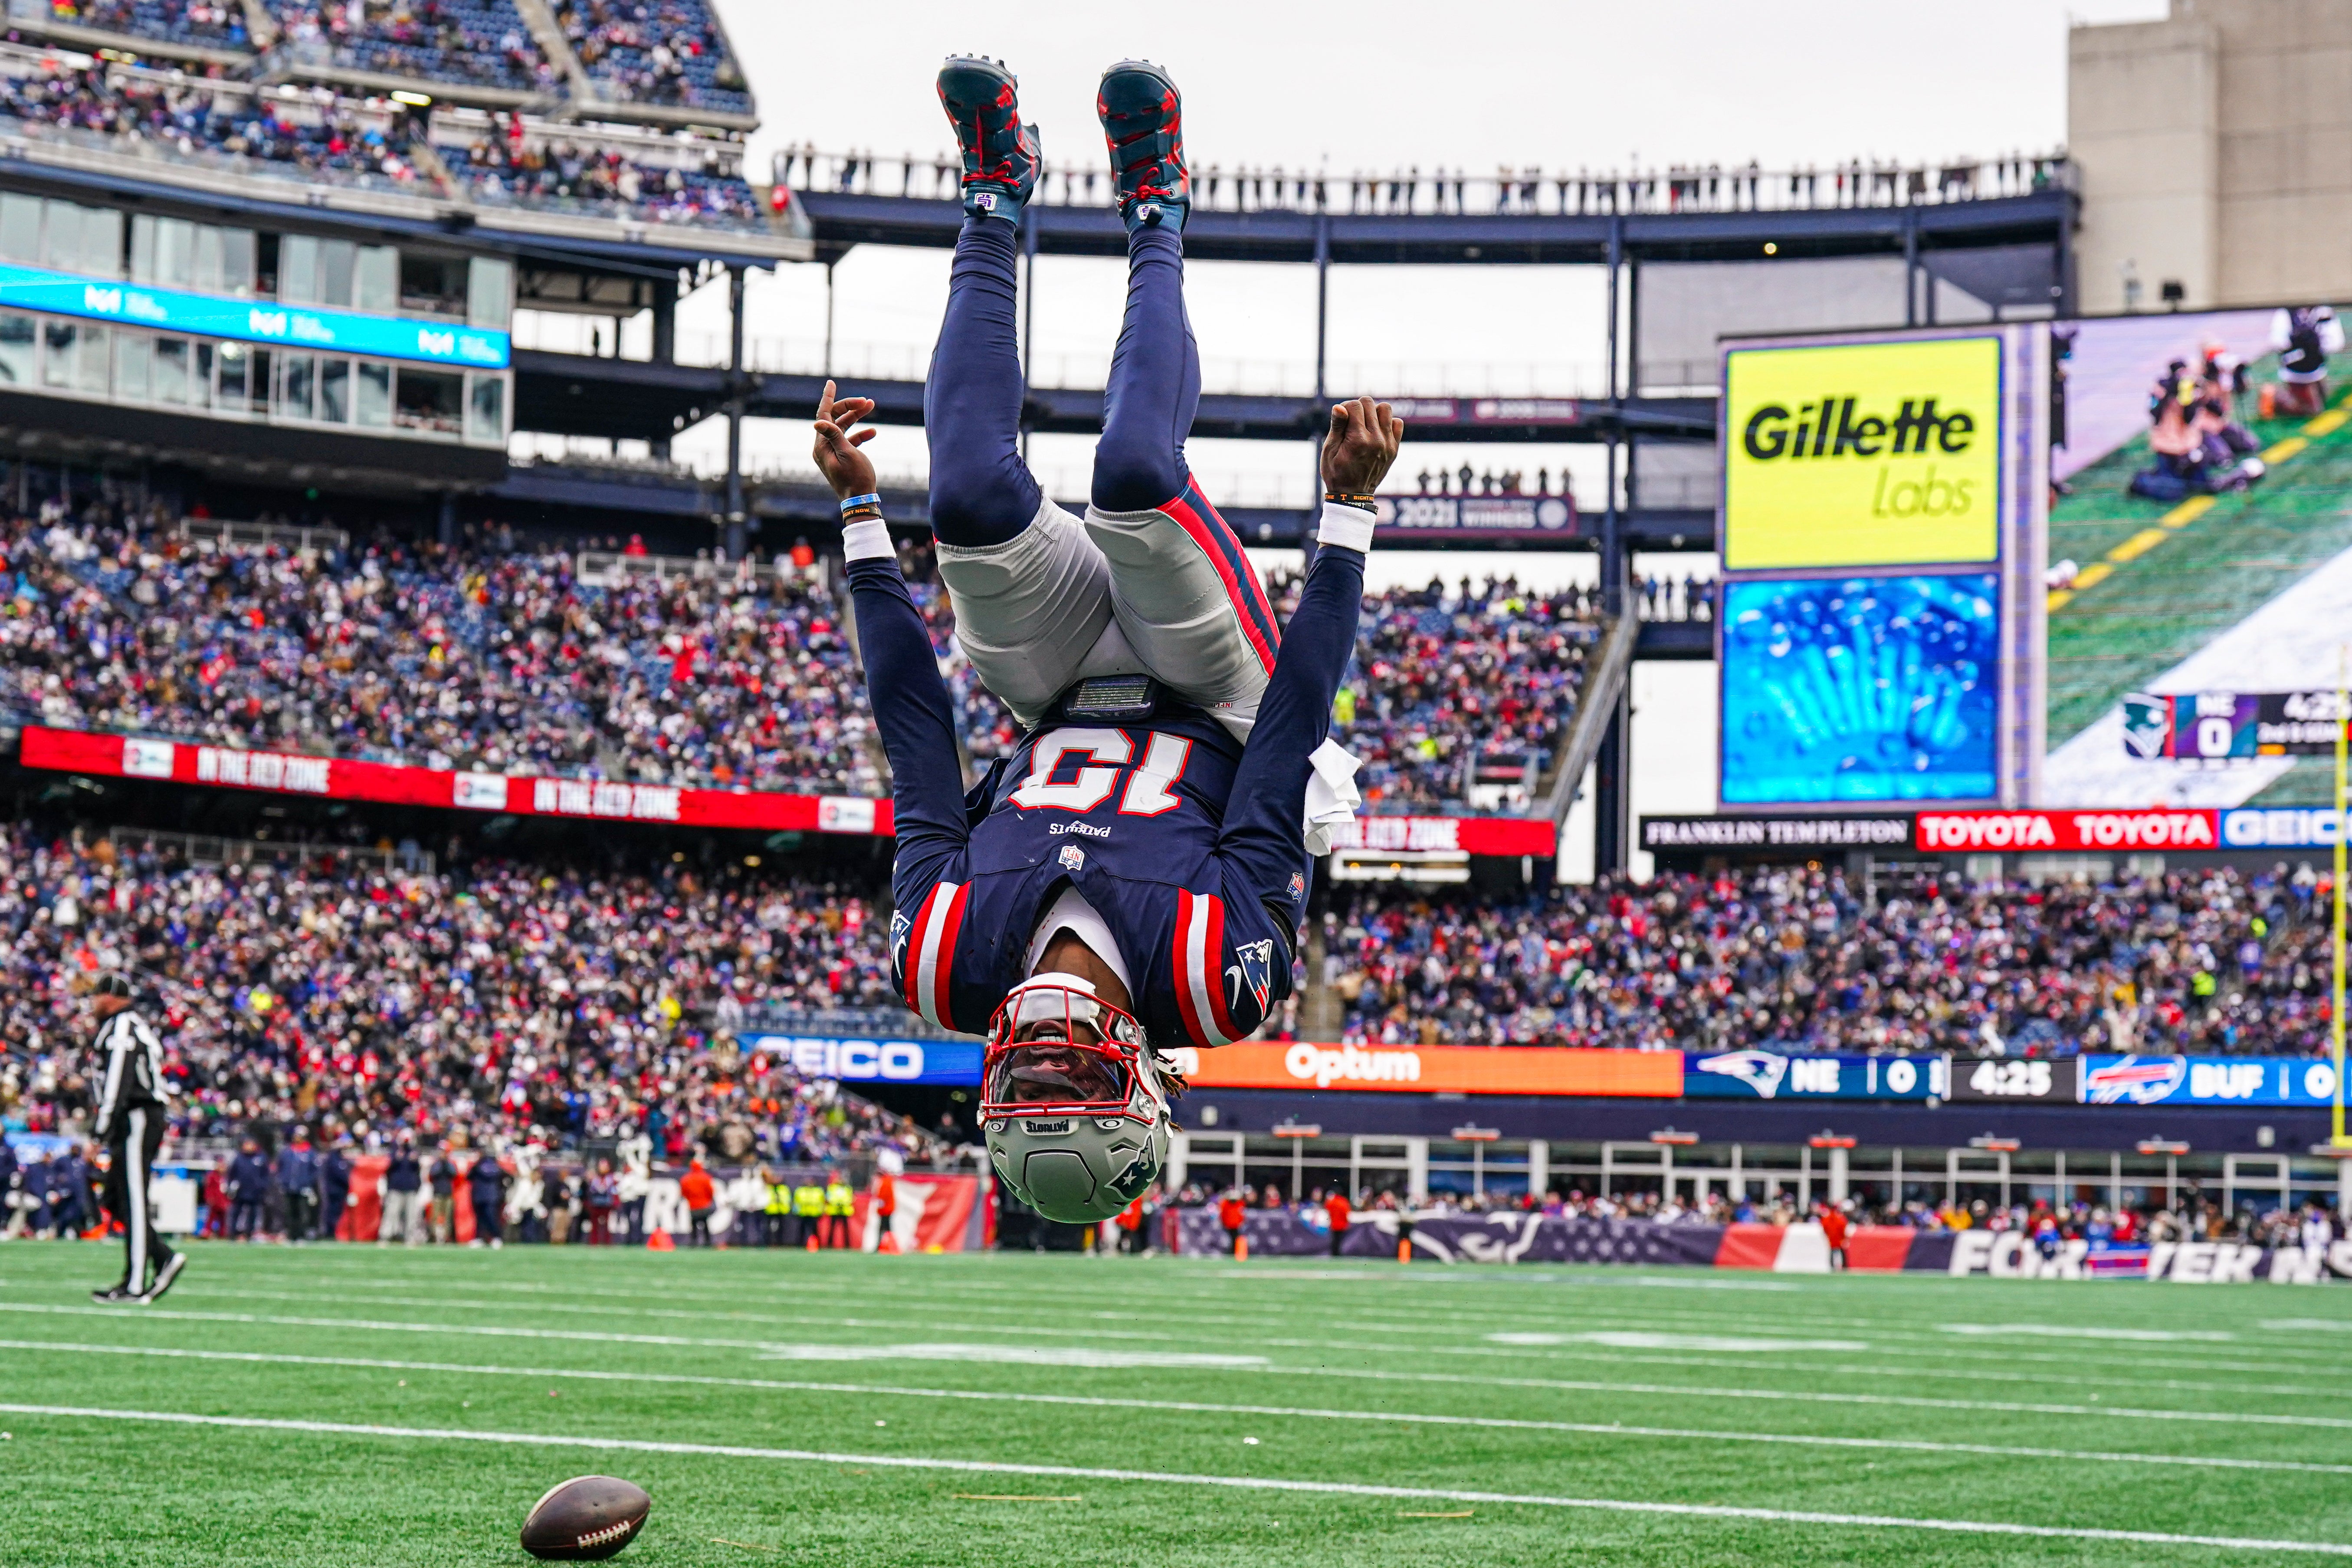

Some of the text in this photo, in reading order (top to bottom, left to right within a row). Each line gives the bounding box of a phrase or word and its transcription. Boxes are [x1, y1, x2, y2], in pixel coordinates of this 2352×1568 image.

[1744, 397, 1974, 461] Gillette
[1872, 465, 1974, 518] Labs
[1397, 498, 1458, 527] 2021
[2198, 718, 2233, 757] 0
[534, 778, 557, 812] IN
[632, 785, 681, 821] ZONE
[1647, 820, 1908, 844] FRANKLIN TEMPLETON
[1919, 814, 2214, 847] TOYOTA TOYOTA
[2224, 809, 2352, 846] GEIC
[1066, 849, 1080, 861] NFL
[1285, 1043, 1421, 1088] Optum
[1791, 1058, 2337, 1099] NE 0 4:25 BUF 0
[1025, 1119, 1069, 1133] PATRIOTS
